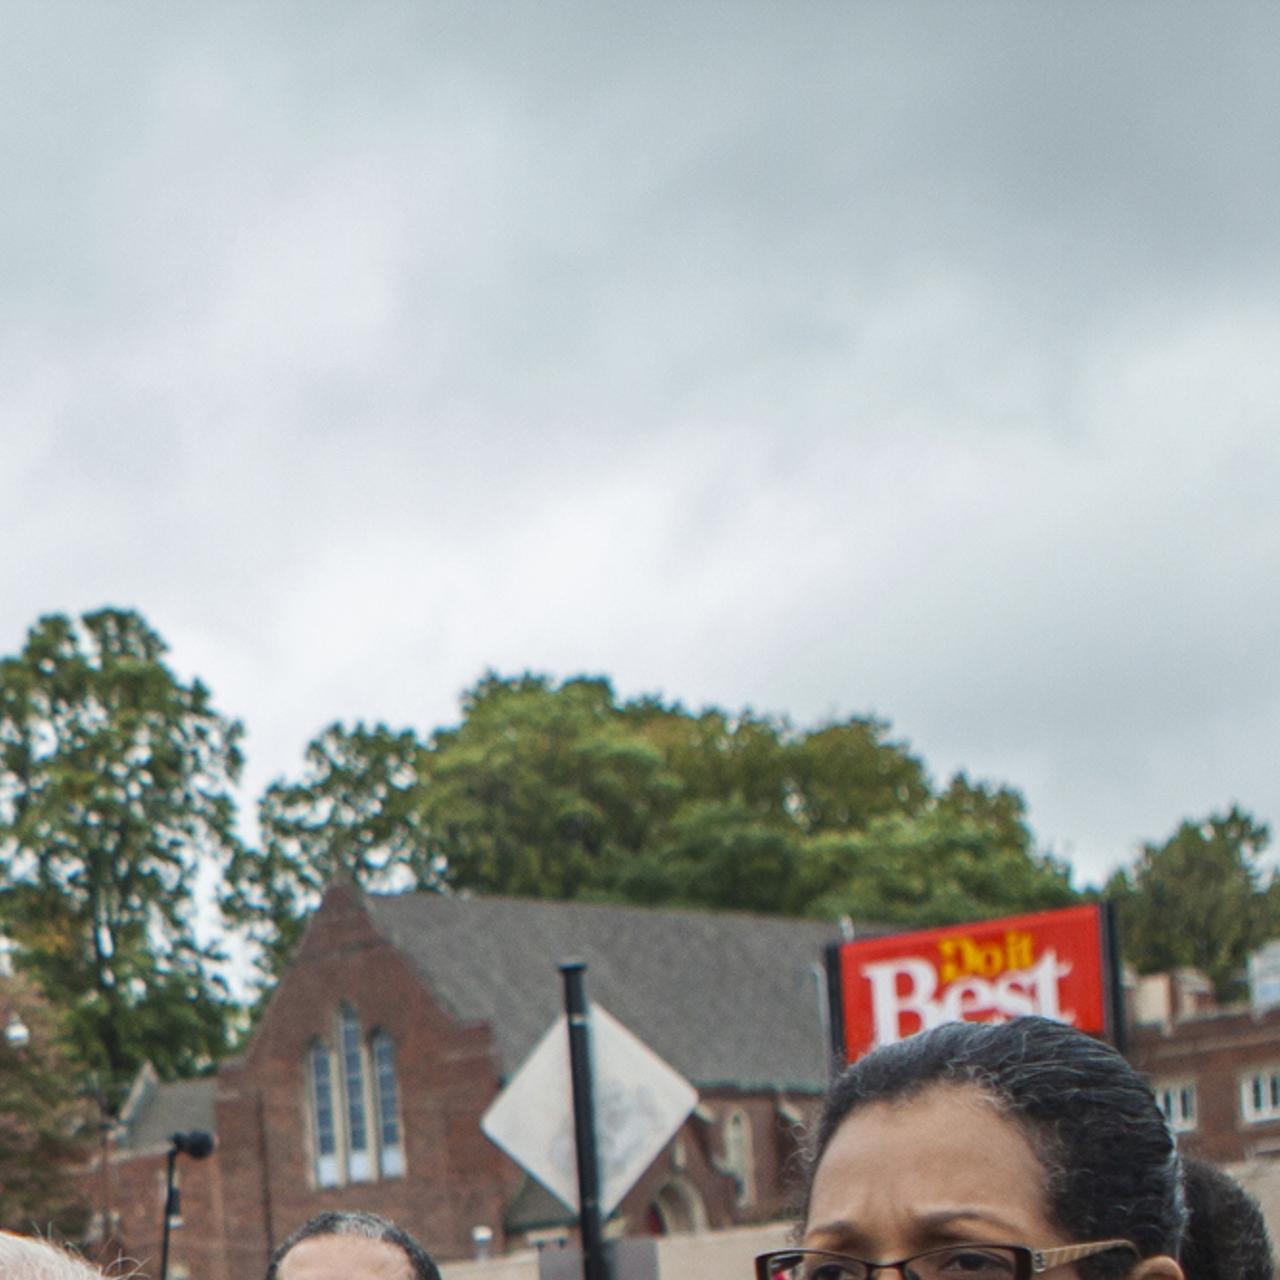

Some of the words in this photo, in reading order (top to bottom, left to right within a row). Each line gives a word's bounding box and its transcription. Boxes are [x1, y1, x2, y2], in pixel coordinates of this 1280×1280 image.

[941, 936, 1003, 982] Do
[1005, 929, 1033, 970] it
[862, 946, 1075, 1051] Best
